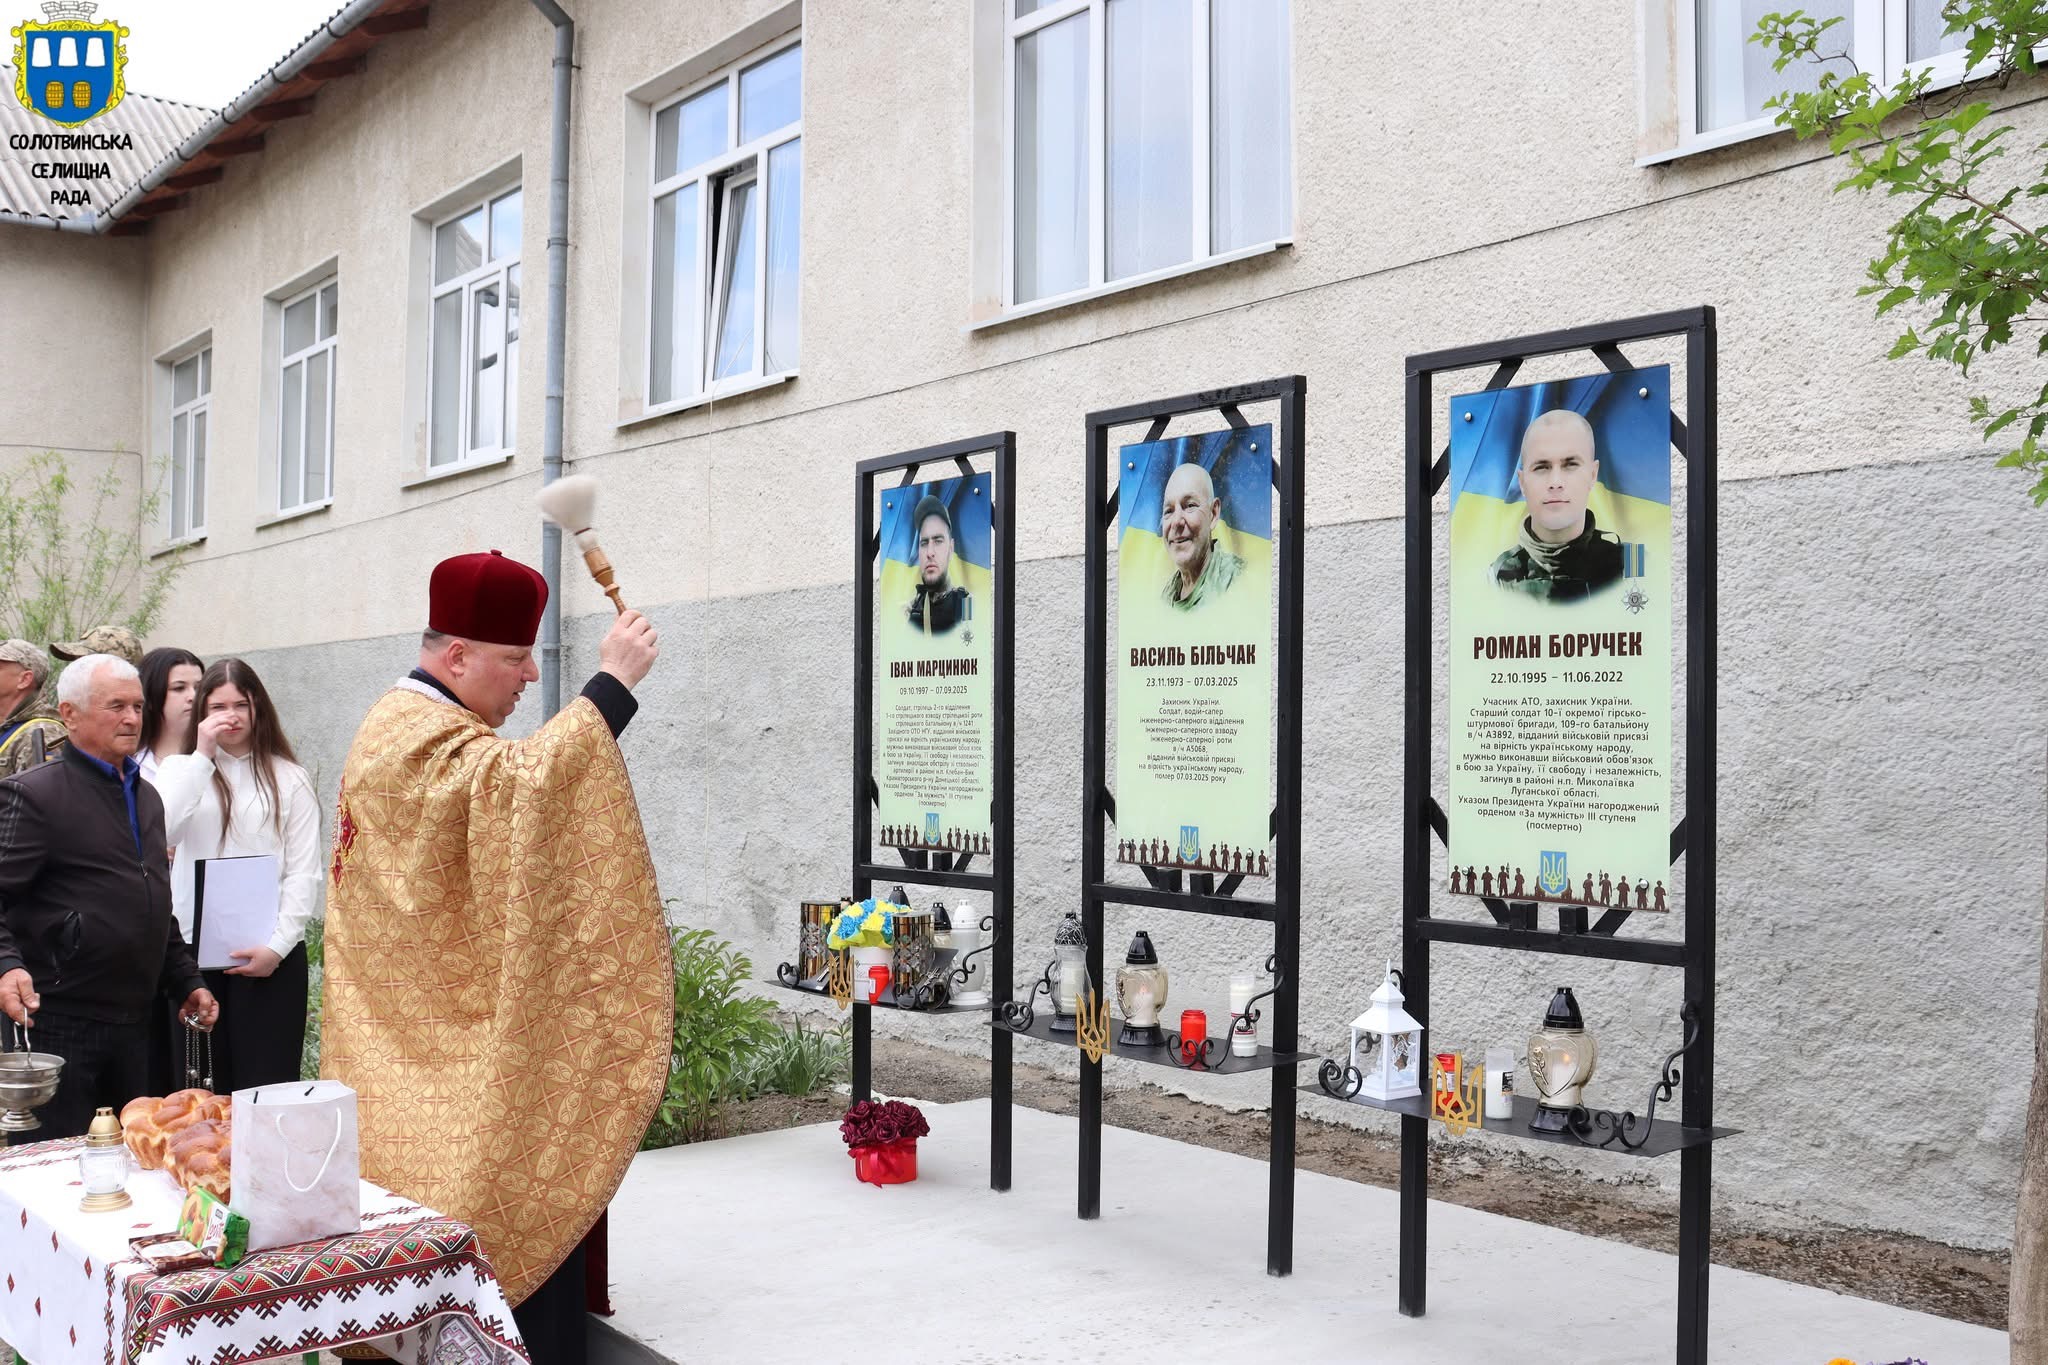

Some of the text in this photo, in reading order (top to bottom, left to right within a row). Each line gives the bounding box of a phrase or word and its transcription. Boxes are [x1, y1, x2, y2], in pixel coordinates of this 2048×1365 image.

[1473, 631, 1643, 659] РОМАН БОРУЧЕК
[1130, 644, 1256, 667] ВАСИЛЬ БІЛЬЧАК
[890, 658, 978, 679] ІВАН МАРЦИНЮК
[1146, 677, 1184, 687] 23.11.1973
[1194, 676, 1238, 686] 07.03.2025
[1490, 672, 1547, 683] 22.10.1995
[1563, 671, 1623, 683] 11.06.2022
[1482, 697, 1518, 706] Учасник
[1521, 697, 1542, 707] АТО,
[1591, 696, 1632, 707] України.
[1159, 707, 1224, 716] Солдат, водій-сапер
[1470, 708, 1647, 719] Старший солдат 10-ї окремої гірсько-
[1467, 719, 1649, 731] штурмової бригади, 109-го батальйону
[1467, 730, 1649, 742] в/ч А3892, відданий військовій присязі
[1493, 742, 1528, 752] вірність
[1530, 742, 1594, 754] українському
[1596, 744, 1634, 754] народу,
[1463, 753, 1653, 764] мужньо виконавши військовий обов'язок
[1464, 763, 1481, 772] бою
[1496, 763, 1535, 774] Україну,
[1537, 764, 1545, 772] її
[1548, 765, 1586, 776] свободу
[1595, 767, 1662, 778] незалежність,
[1479, 776, 1513, 784] загинув
[1524, 776, 1554, 786] районі
[1576, 777, 1635, 788] Миколаївка
[1511, 786, 1600, 798] Луганської області.
[1458, 795, 1660, 812] Указом Президента України нагороджений
[1477, 808, 1516, 818] орденом
[1519, 809, 1534, 818] «За
[1537, 811, 1584, 821] мужність»
[1599, 814, 1636, 823] ступеня
[1526, 820, 1582, 833] (посмертно)
